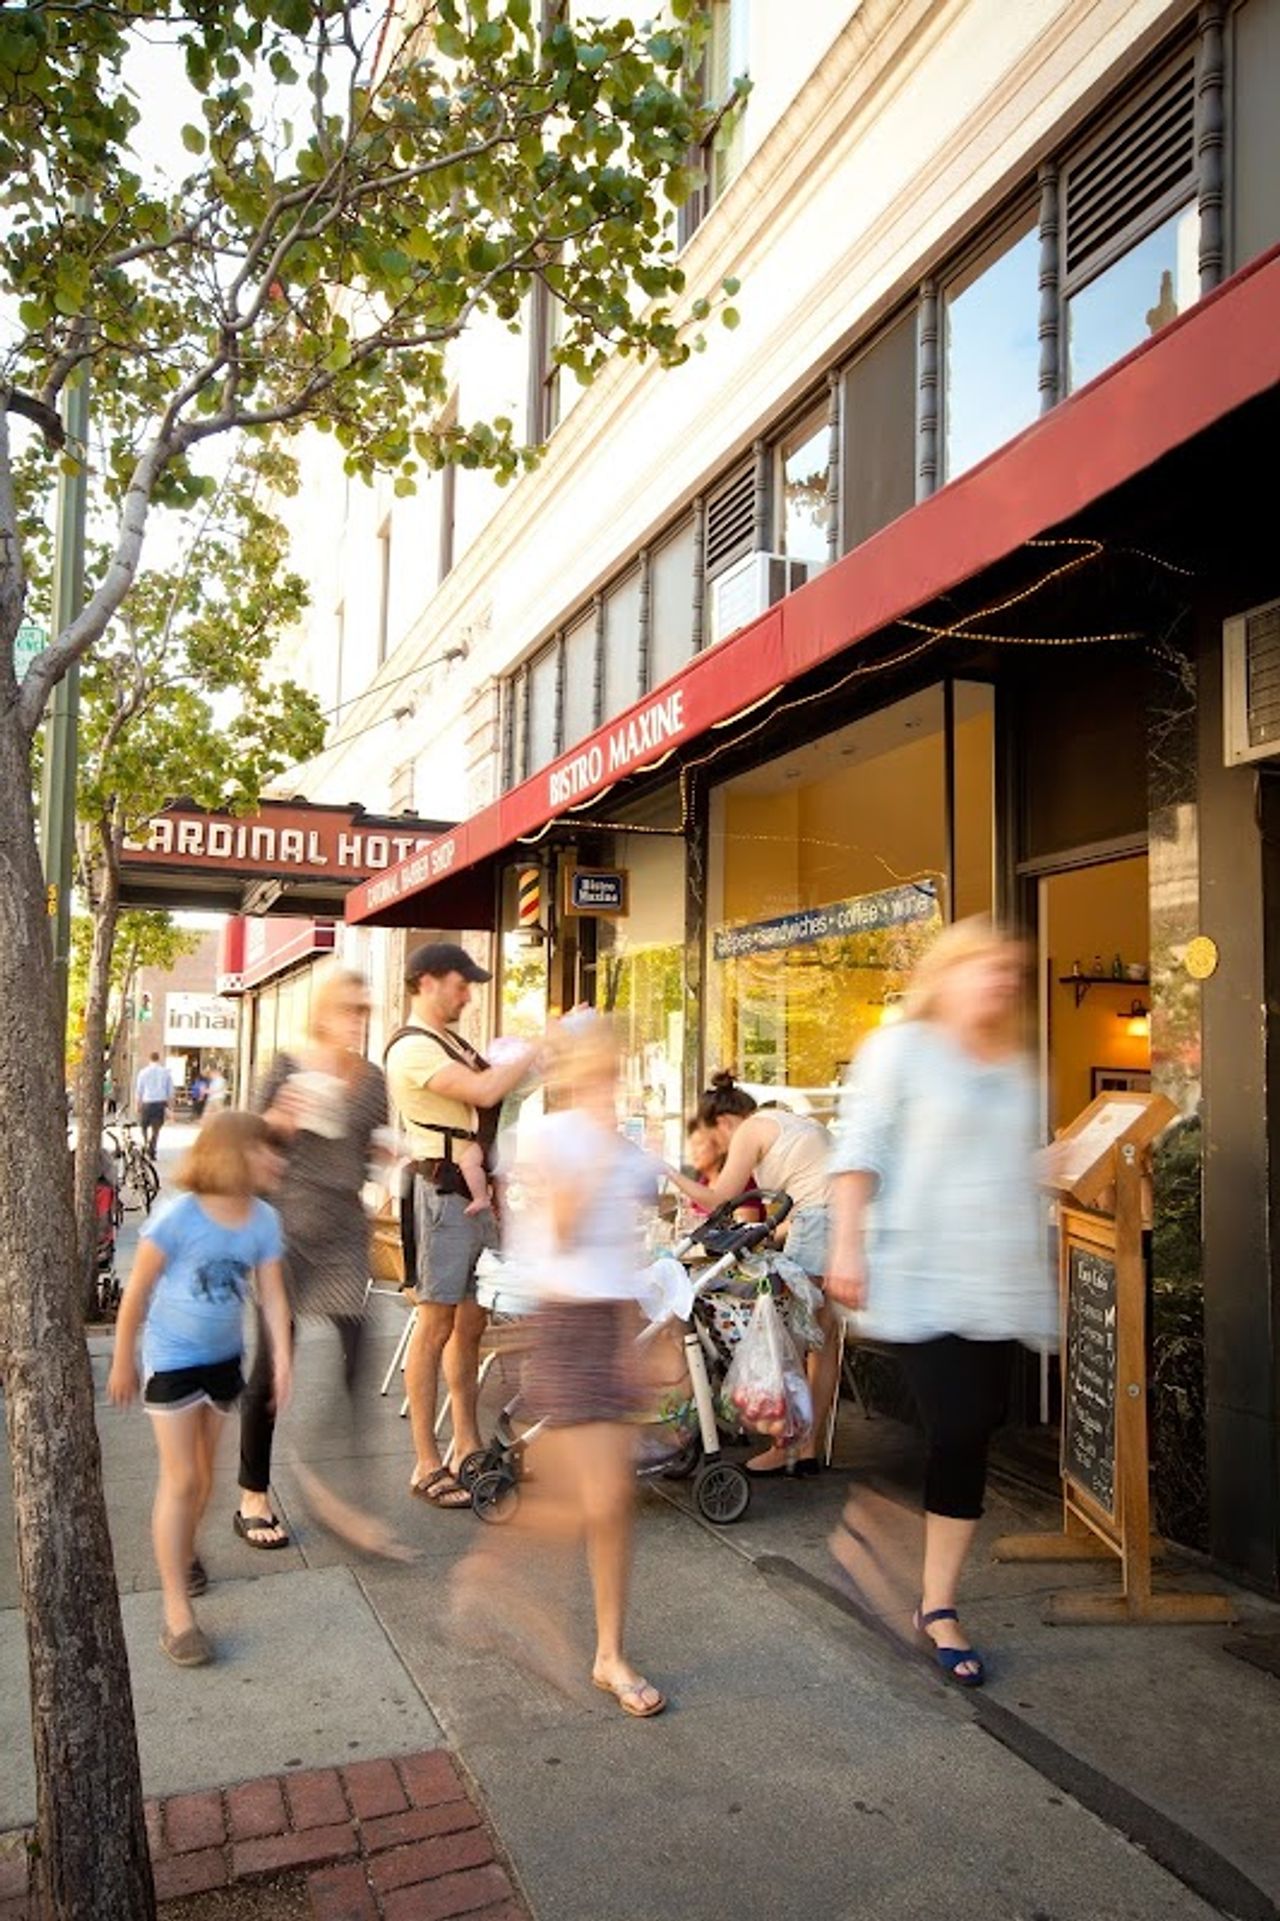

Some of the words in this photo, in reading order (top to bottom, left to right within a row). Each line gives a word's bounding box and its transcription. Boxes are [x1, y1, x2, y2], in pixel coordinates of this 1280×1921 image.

[549, 745, 603, 807] BISTRO
[608, 689, 686, 772] MAXINE
[581, 879, 616, 892] Bistro
[579, 889, 618, 902] Maxine
[837, 903, 878, 929] coffee
